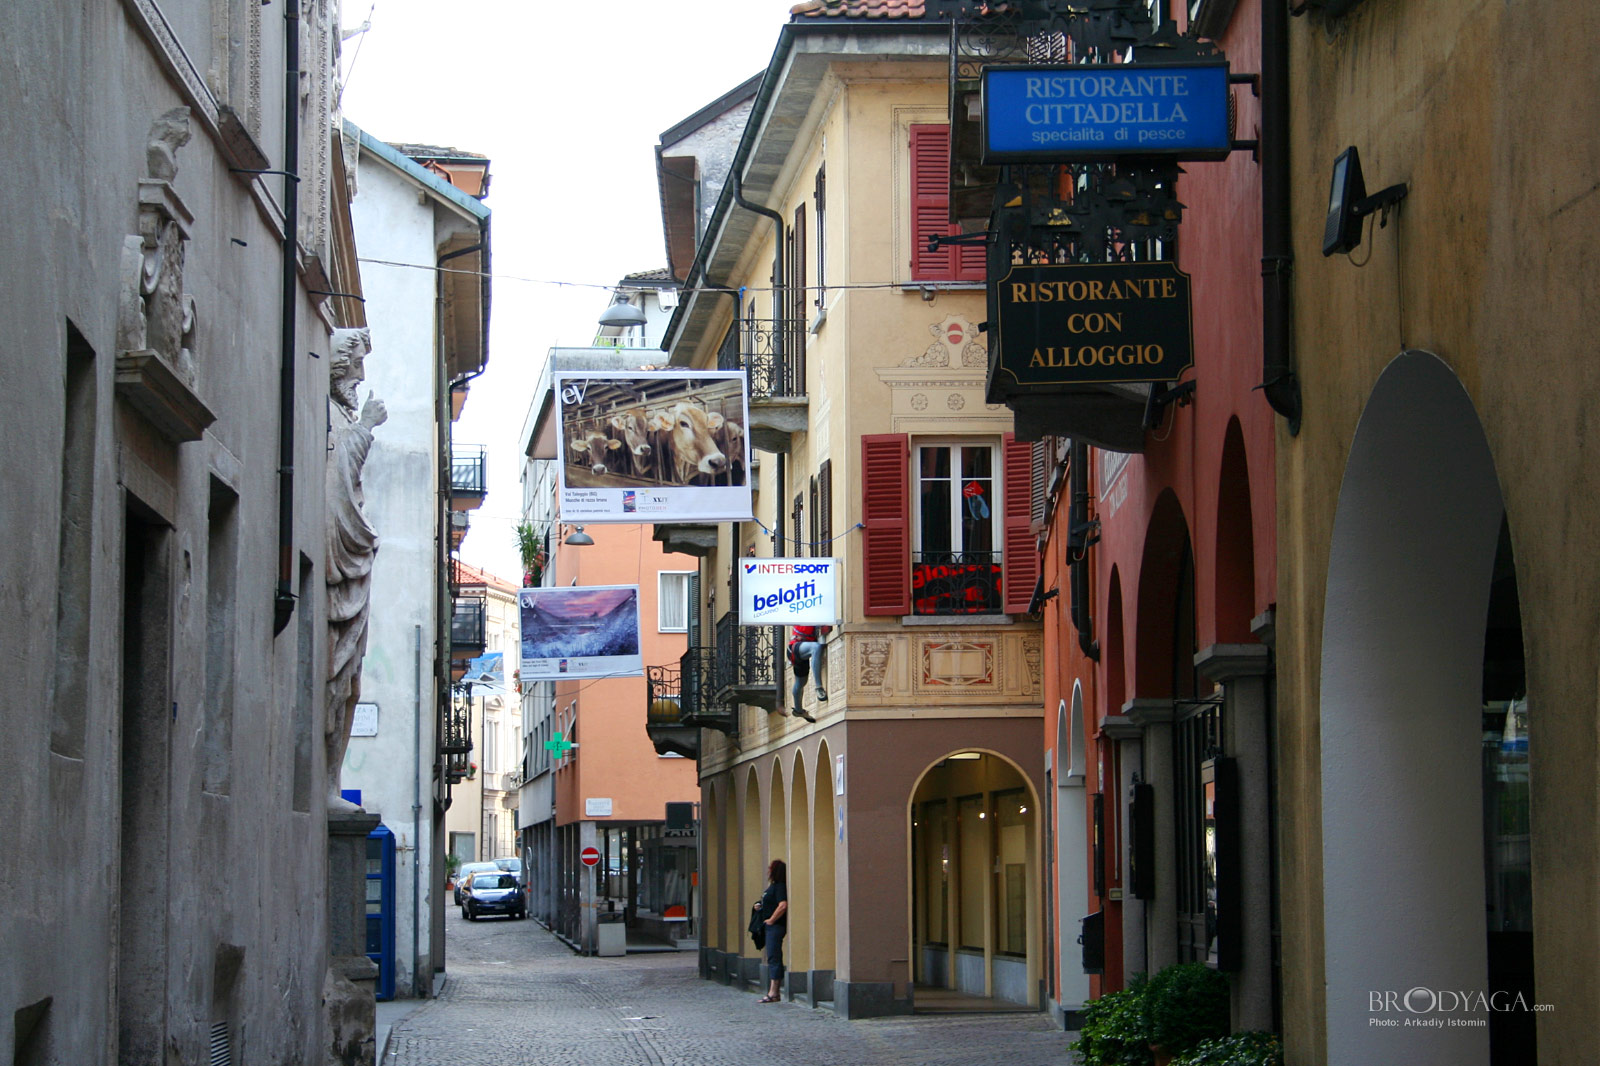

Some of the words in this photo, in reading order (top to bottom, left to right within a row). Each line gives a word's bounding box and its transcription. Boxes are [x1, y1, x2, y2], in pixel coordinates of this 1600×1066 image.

[1026, 76, 1189, 98] RISTORANTE
[1026, 102, 1188, 125] CITTADELLA
[1114, 127, 1128, 141] di
[1139, 128, 1186, 143] pesce
[1011, 278, 1177, 303] RISTORANTE
[1067, 312, 1122, 334] CON
[1029, 344, 1164, 367] ALLOGGIO
[758, 564, 829, 573] INTERSPORT
[753, 579, 815, 611] belotti
[789, 593, 823, 614] sport
